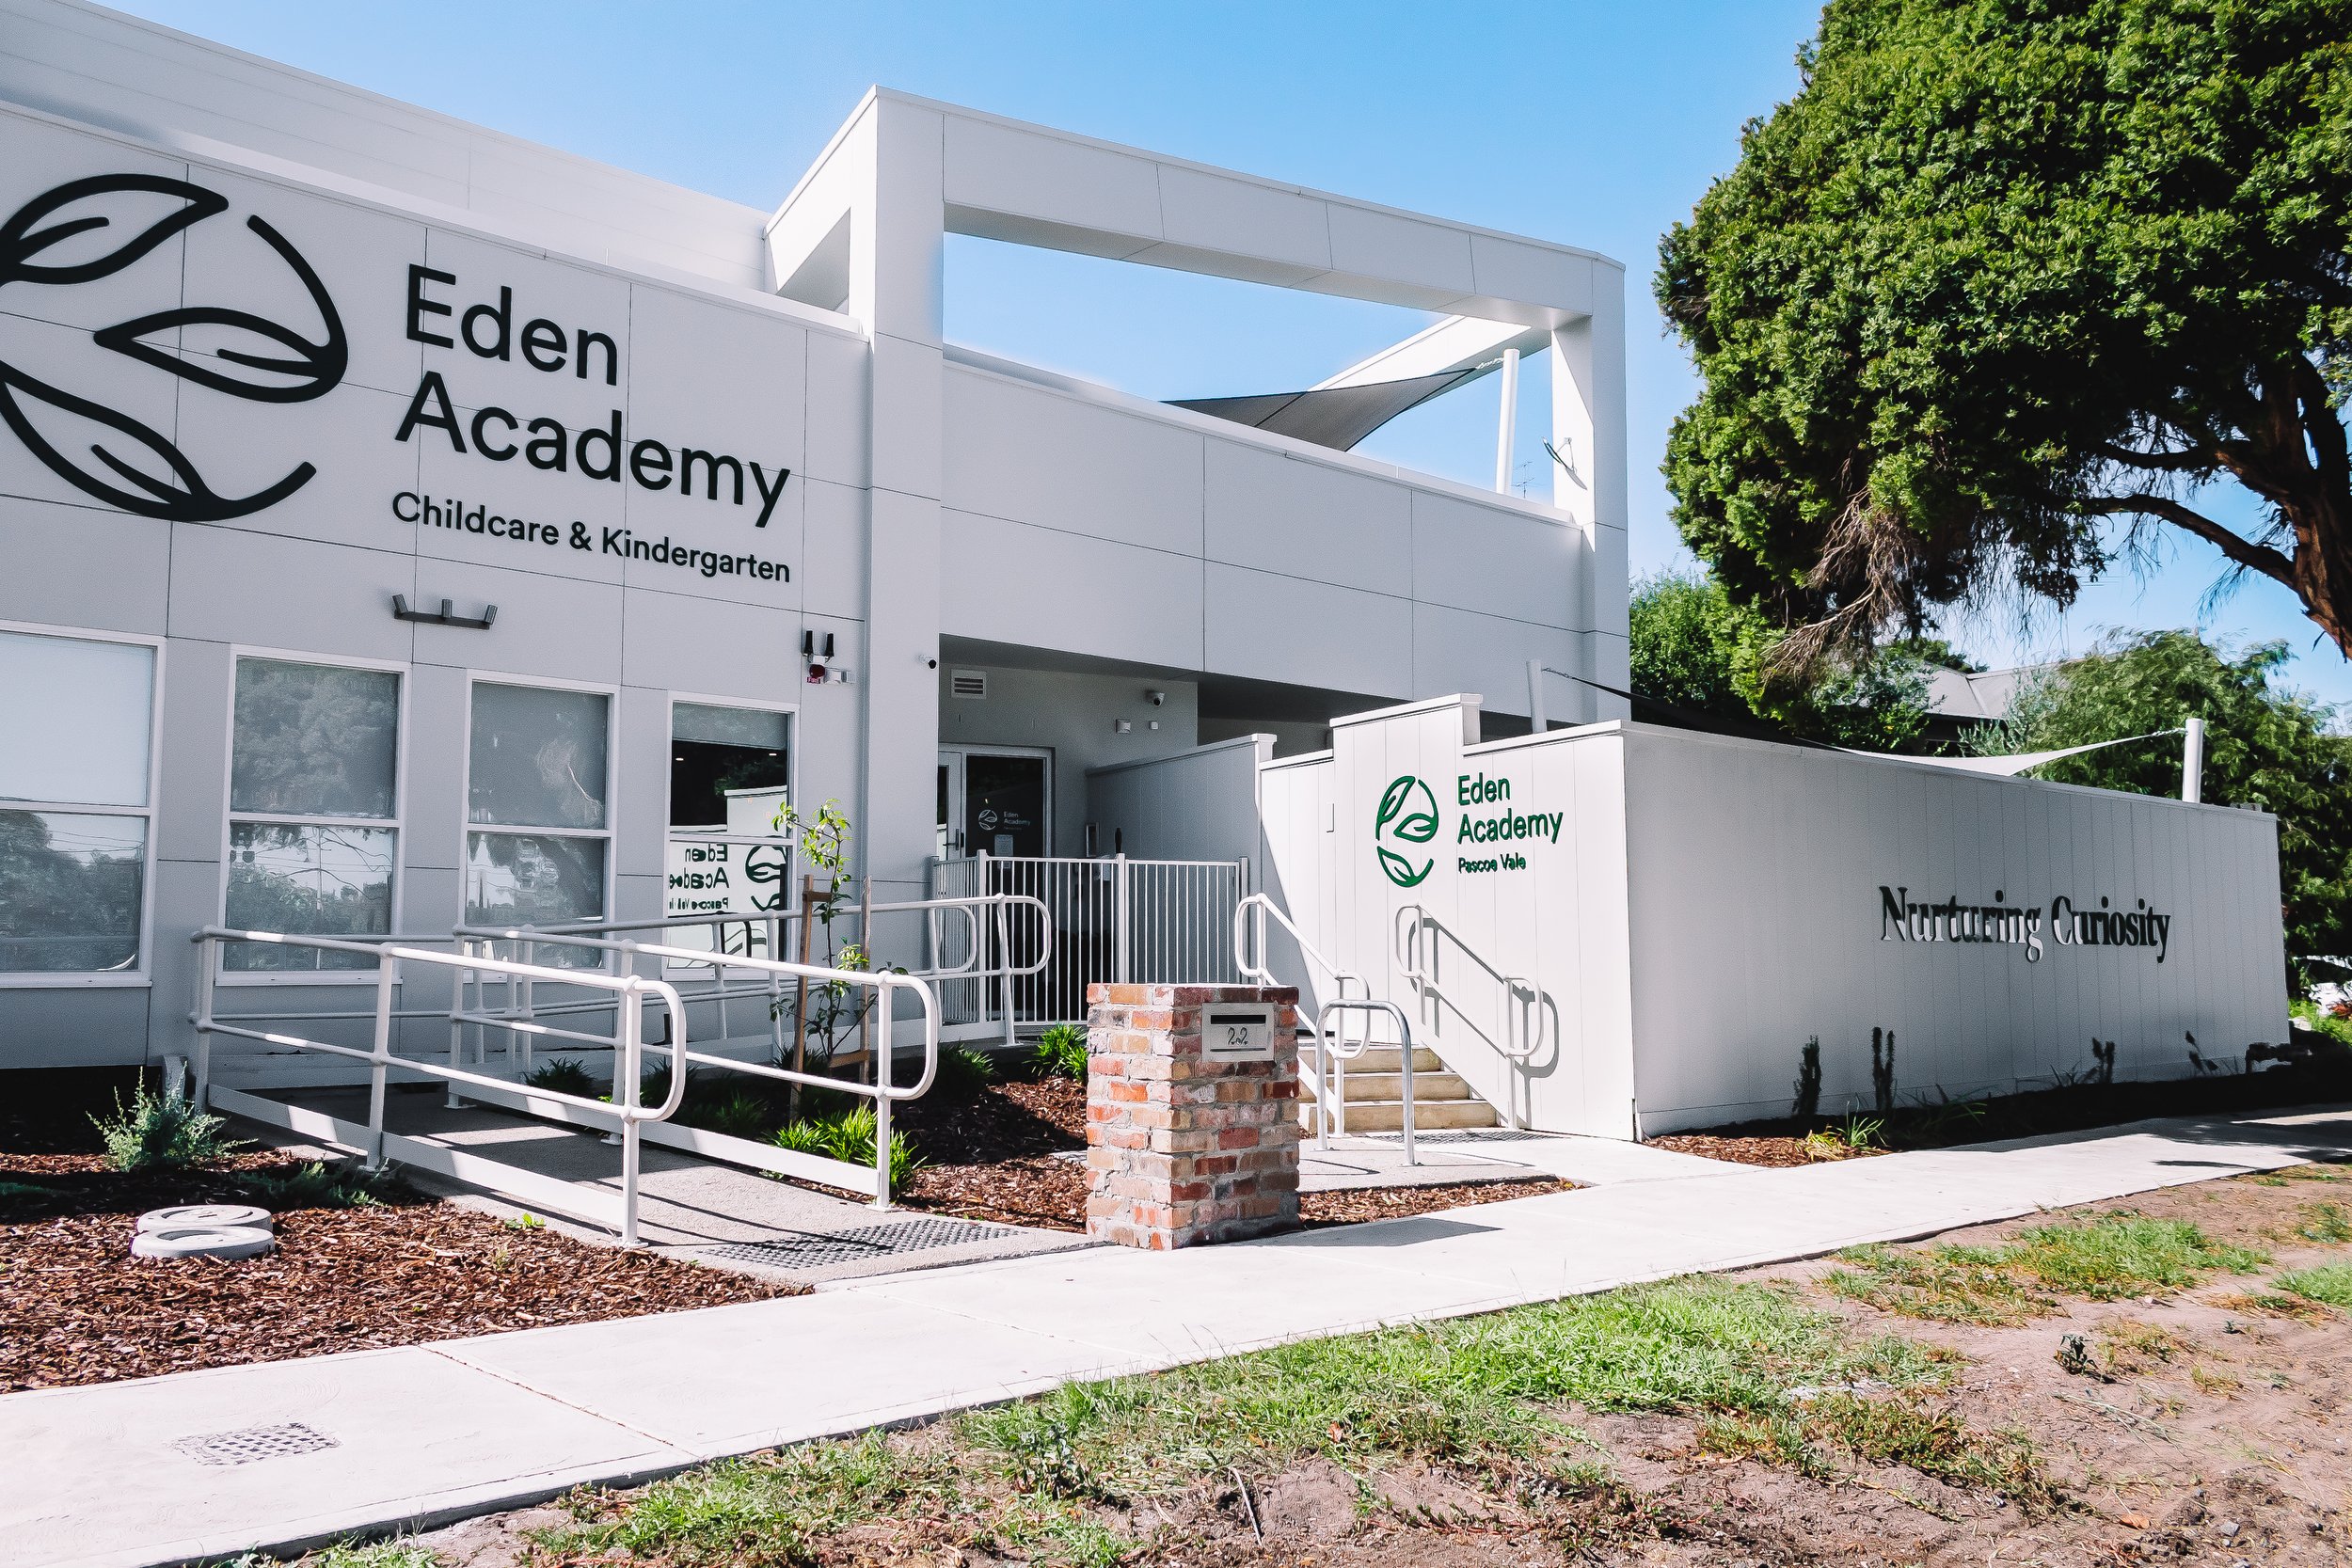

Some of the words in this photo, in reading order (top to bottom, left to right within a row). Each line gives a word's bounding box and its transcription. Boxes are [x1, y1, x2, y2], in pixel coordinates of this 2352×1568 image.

[405, 263, 618, 387] Eden
[394, 371, 791, 529] Academy
[392, 491, 560, 546] Childcare
[569, 521, 593, 551] &
[602, 527, 791, 583] Kindergarten
[1457, 807, 1564, 845] Academy
[1458, 771, 1511, 806] Eden
[1458, 857, 1498, 874] Pascoe
[1500, 852, 1527, 871] Vale
[1879, 885, 2044, 964] Nurturing
[2051, 895, 2172, 964] Curiosity
